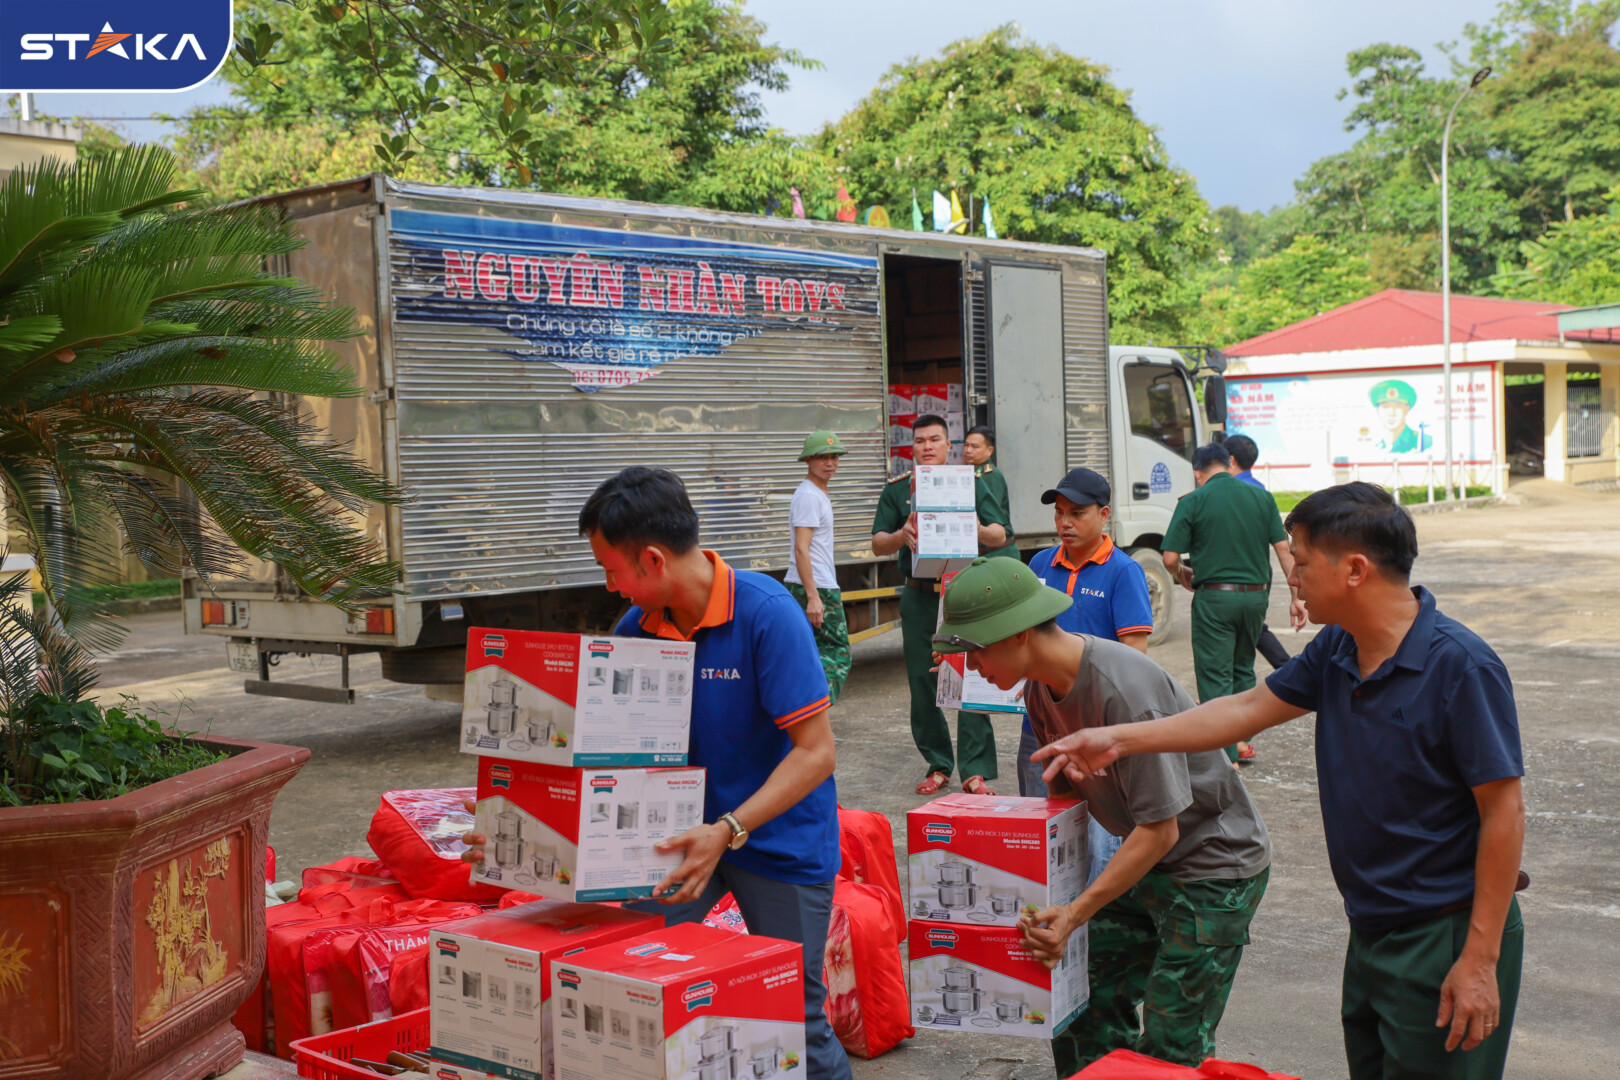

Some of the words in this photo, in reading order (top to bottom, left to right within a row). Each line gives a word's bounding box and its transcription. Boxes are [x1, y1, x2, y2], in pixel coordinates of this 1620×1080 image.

[442, 249, 624, 308] NGUYÊN
[506, 314, 576, 336] Chúng
[1081, 588, 1105, 598] STAKA
[483, 640, 506, 648] SUNHOUSE
[701, 668, 741, 680] STAKA
[384, 933, 430, 953] THÀN
[684, 987, 714, 1000] SUNHOUSE
